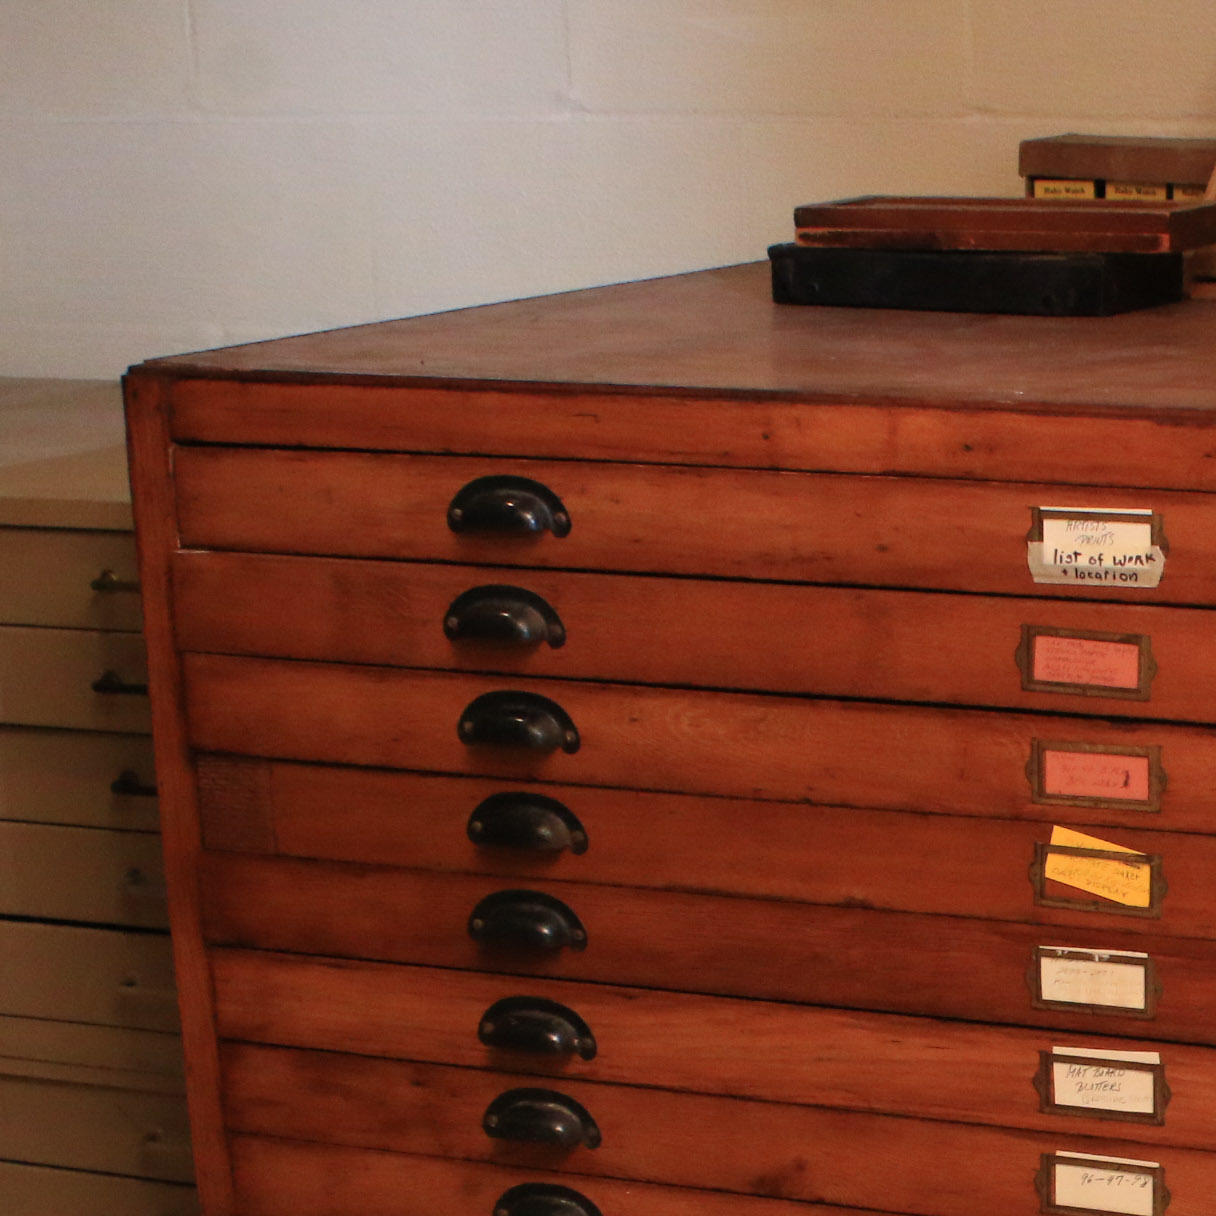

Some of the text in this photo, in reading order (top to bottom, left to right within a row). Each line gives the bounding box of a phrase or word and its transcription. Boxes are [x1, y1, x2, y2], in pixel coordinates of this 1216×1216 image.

[1053, 548, 1082, 565] list
[1088, 553, 1104, 567] of
[1074, 567, 1138, 582] location
